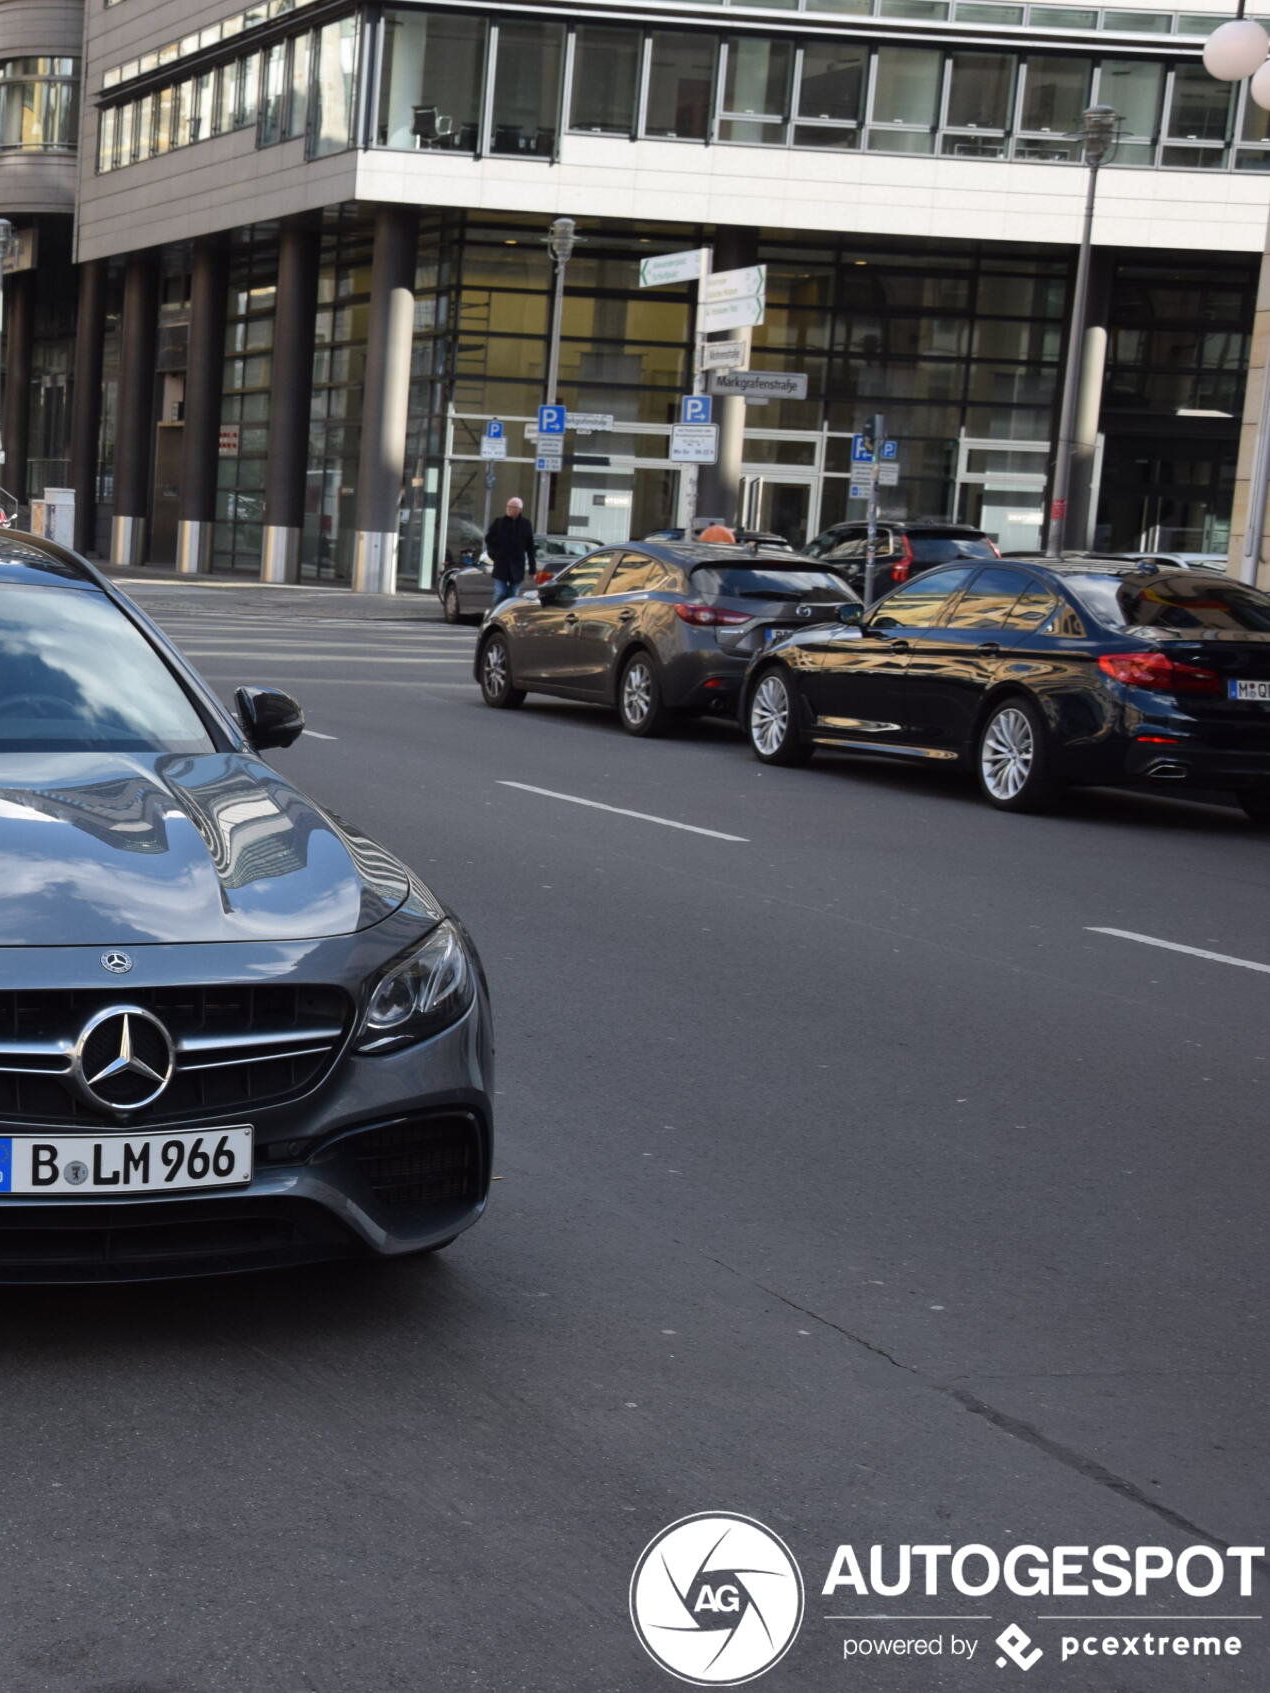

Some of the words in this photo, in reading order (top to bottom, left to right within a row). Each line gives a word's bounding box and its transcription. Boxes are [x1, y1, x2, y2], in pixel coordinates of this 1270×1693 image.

[716, 376, 798, 393] Markgrafenstraße
[687, 400, 702, 420] P
[542, 409, 558, 431] P
[490, 424, 500, 437] P
[1238, 683, 1247, 698] M
[1258, 683, 1270, 698] Q
[32, 1145, 59, 1185] B
[94, 1142, 149, 1185] LM
[161, 1135, 235, 1182] 966
